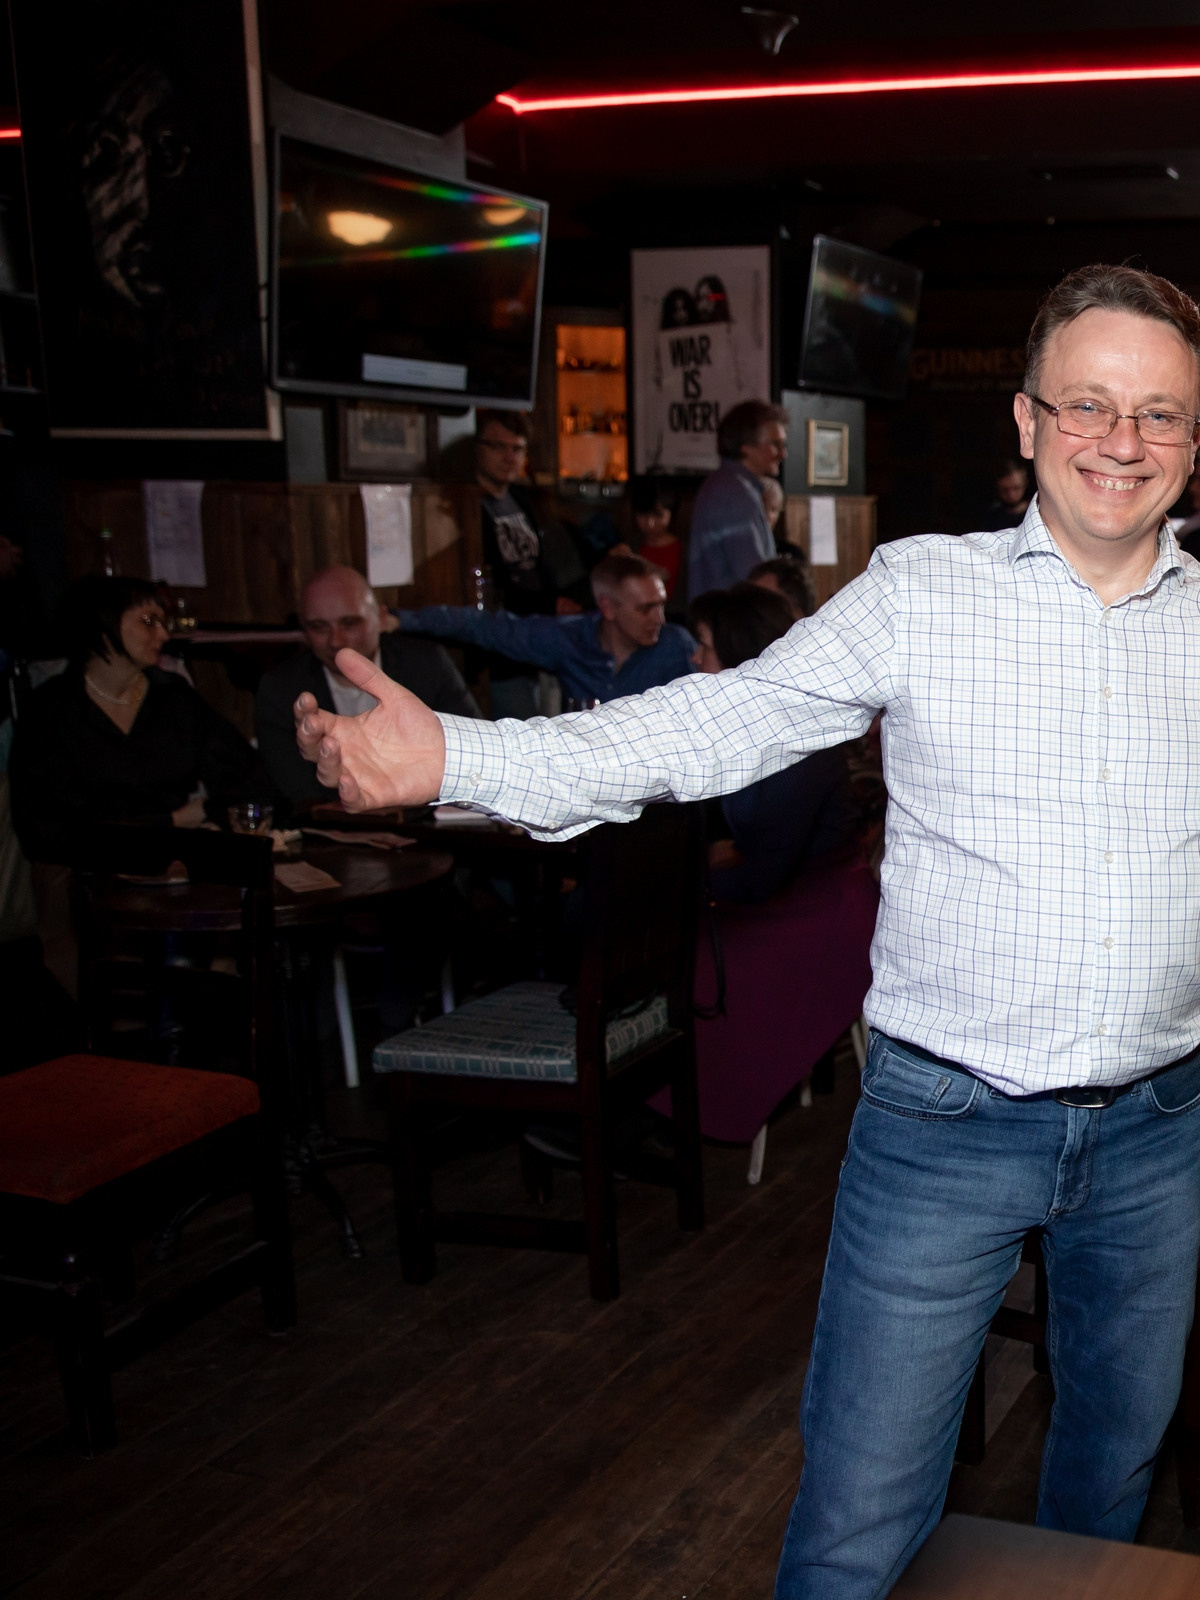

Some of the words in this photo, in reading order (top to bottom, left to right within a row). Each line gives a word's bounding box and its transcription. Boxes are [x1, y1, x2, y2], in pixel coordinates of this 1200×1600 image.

[670, 335, 712, 368] WAR
[909, 347, 1026, 380] GUINNES
[683, 369, 702, 399] IS
[670, 401, 720, 433] OVER!
